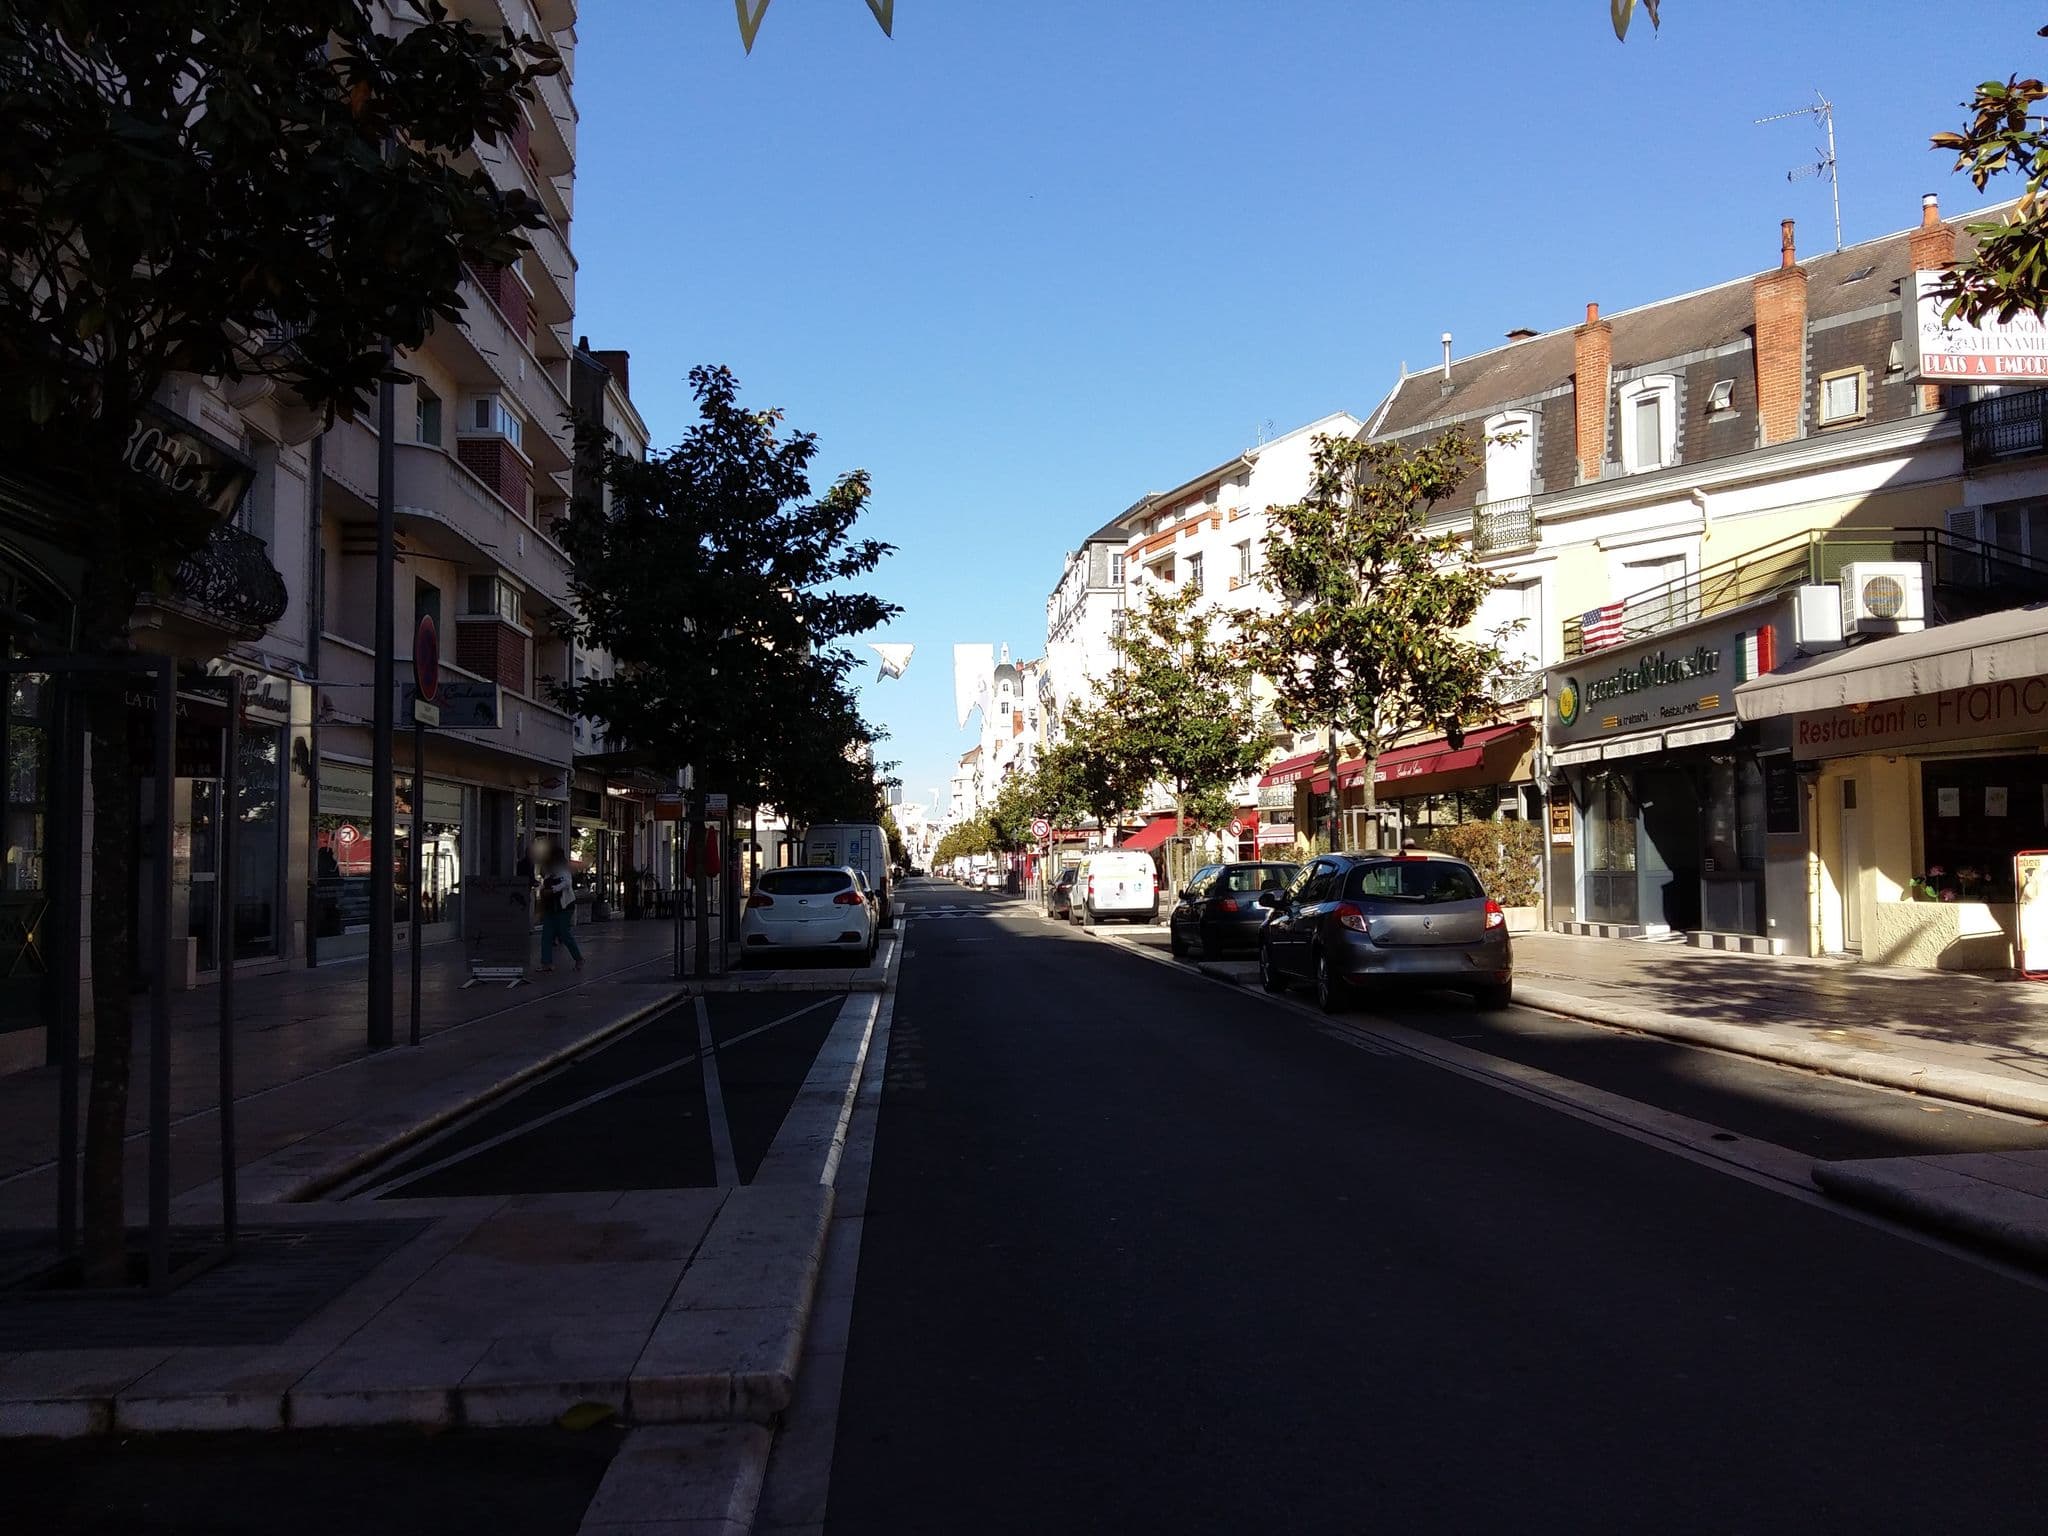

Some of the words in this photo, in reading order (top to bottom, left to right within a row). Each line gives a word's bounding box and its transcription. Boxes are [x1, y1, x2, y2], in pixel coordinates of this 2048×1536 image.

[1923, 354, 1968, 373] PLATS
[1975, 354, 1988, 374] A
[1660, 701, 1700, 718] Restaurant
[1799, 705, 1906, 745] Restaurant
[1913, 710, 1928, 729] le
